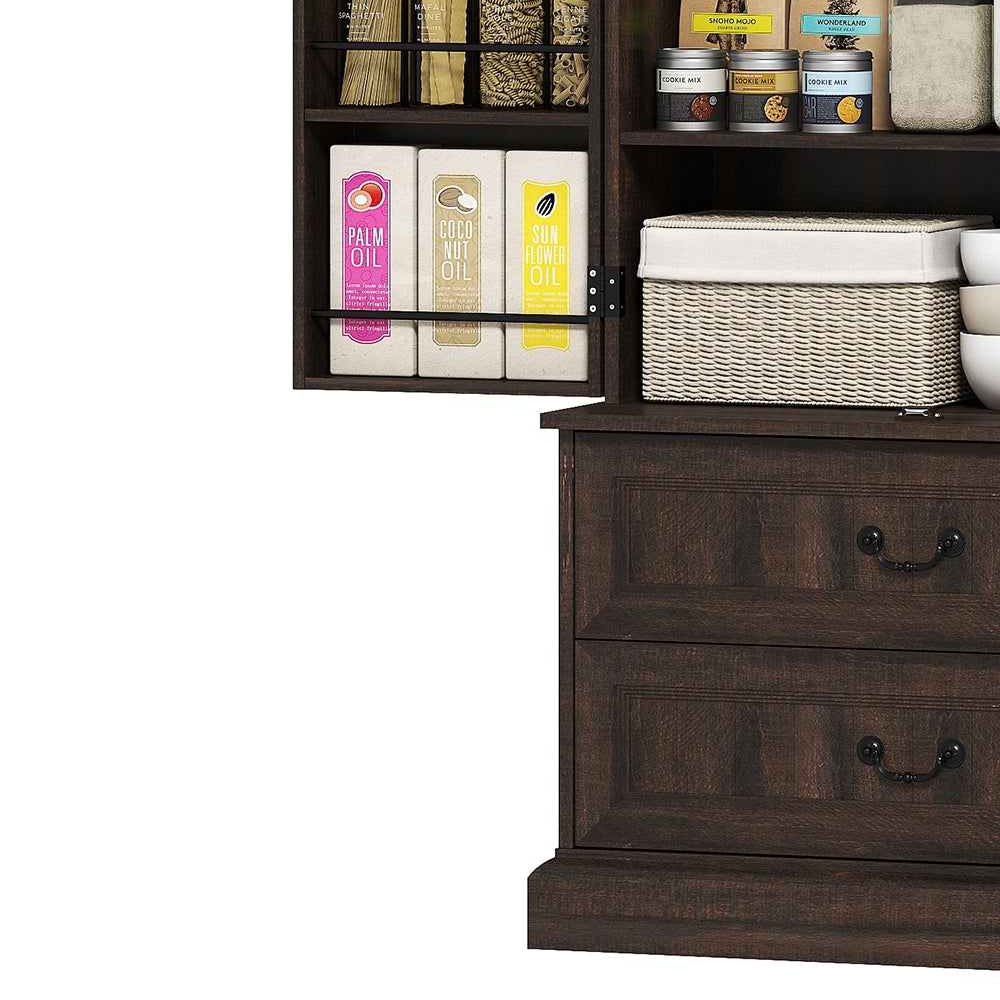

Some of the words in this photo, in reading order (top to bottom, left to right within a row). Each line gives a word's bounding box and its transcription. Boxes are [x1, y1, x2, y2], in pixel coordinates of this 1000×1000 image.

[348, 227, 384, 246] PALM
[440, 220, 473, 239] COCO
[532, 224, 558, 244] SUN
[351, 248, 382, 268] OIL
[444, 241, 468, 260] NUT
[525, 245, 564, 265] FLOWER
[442, 261, 472, 280] OIL
[530, 266, 561, 286] OIL
